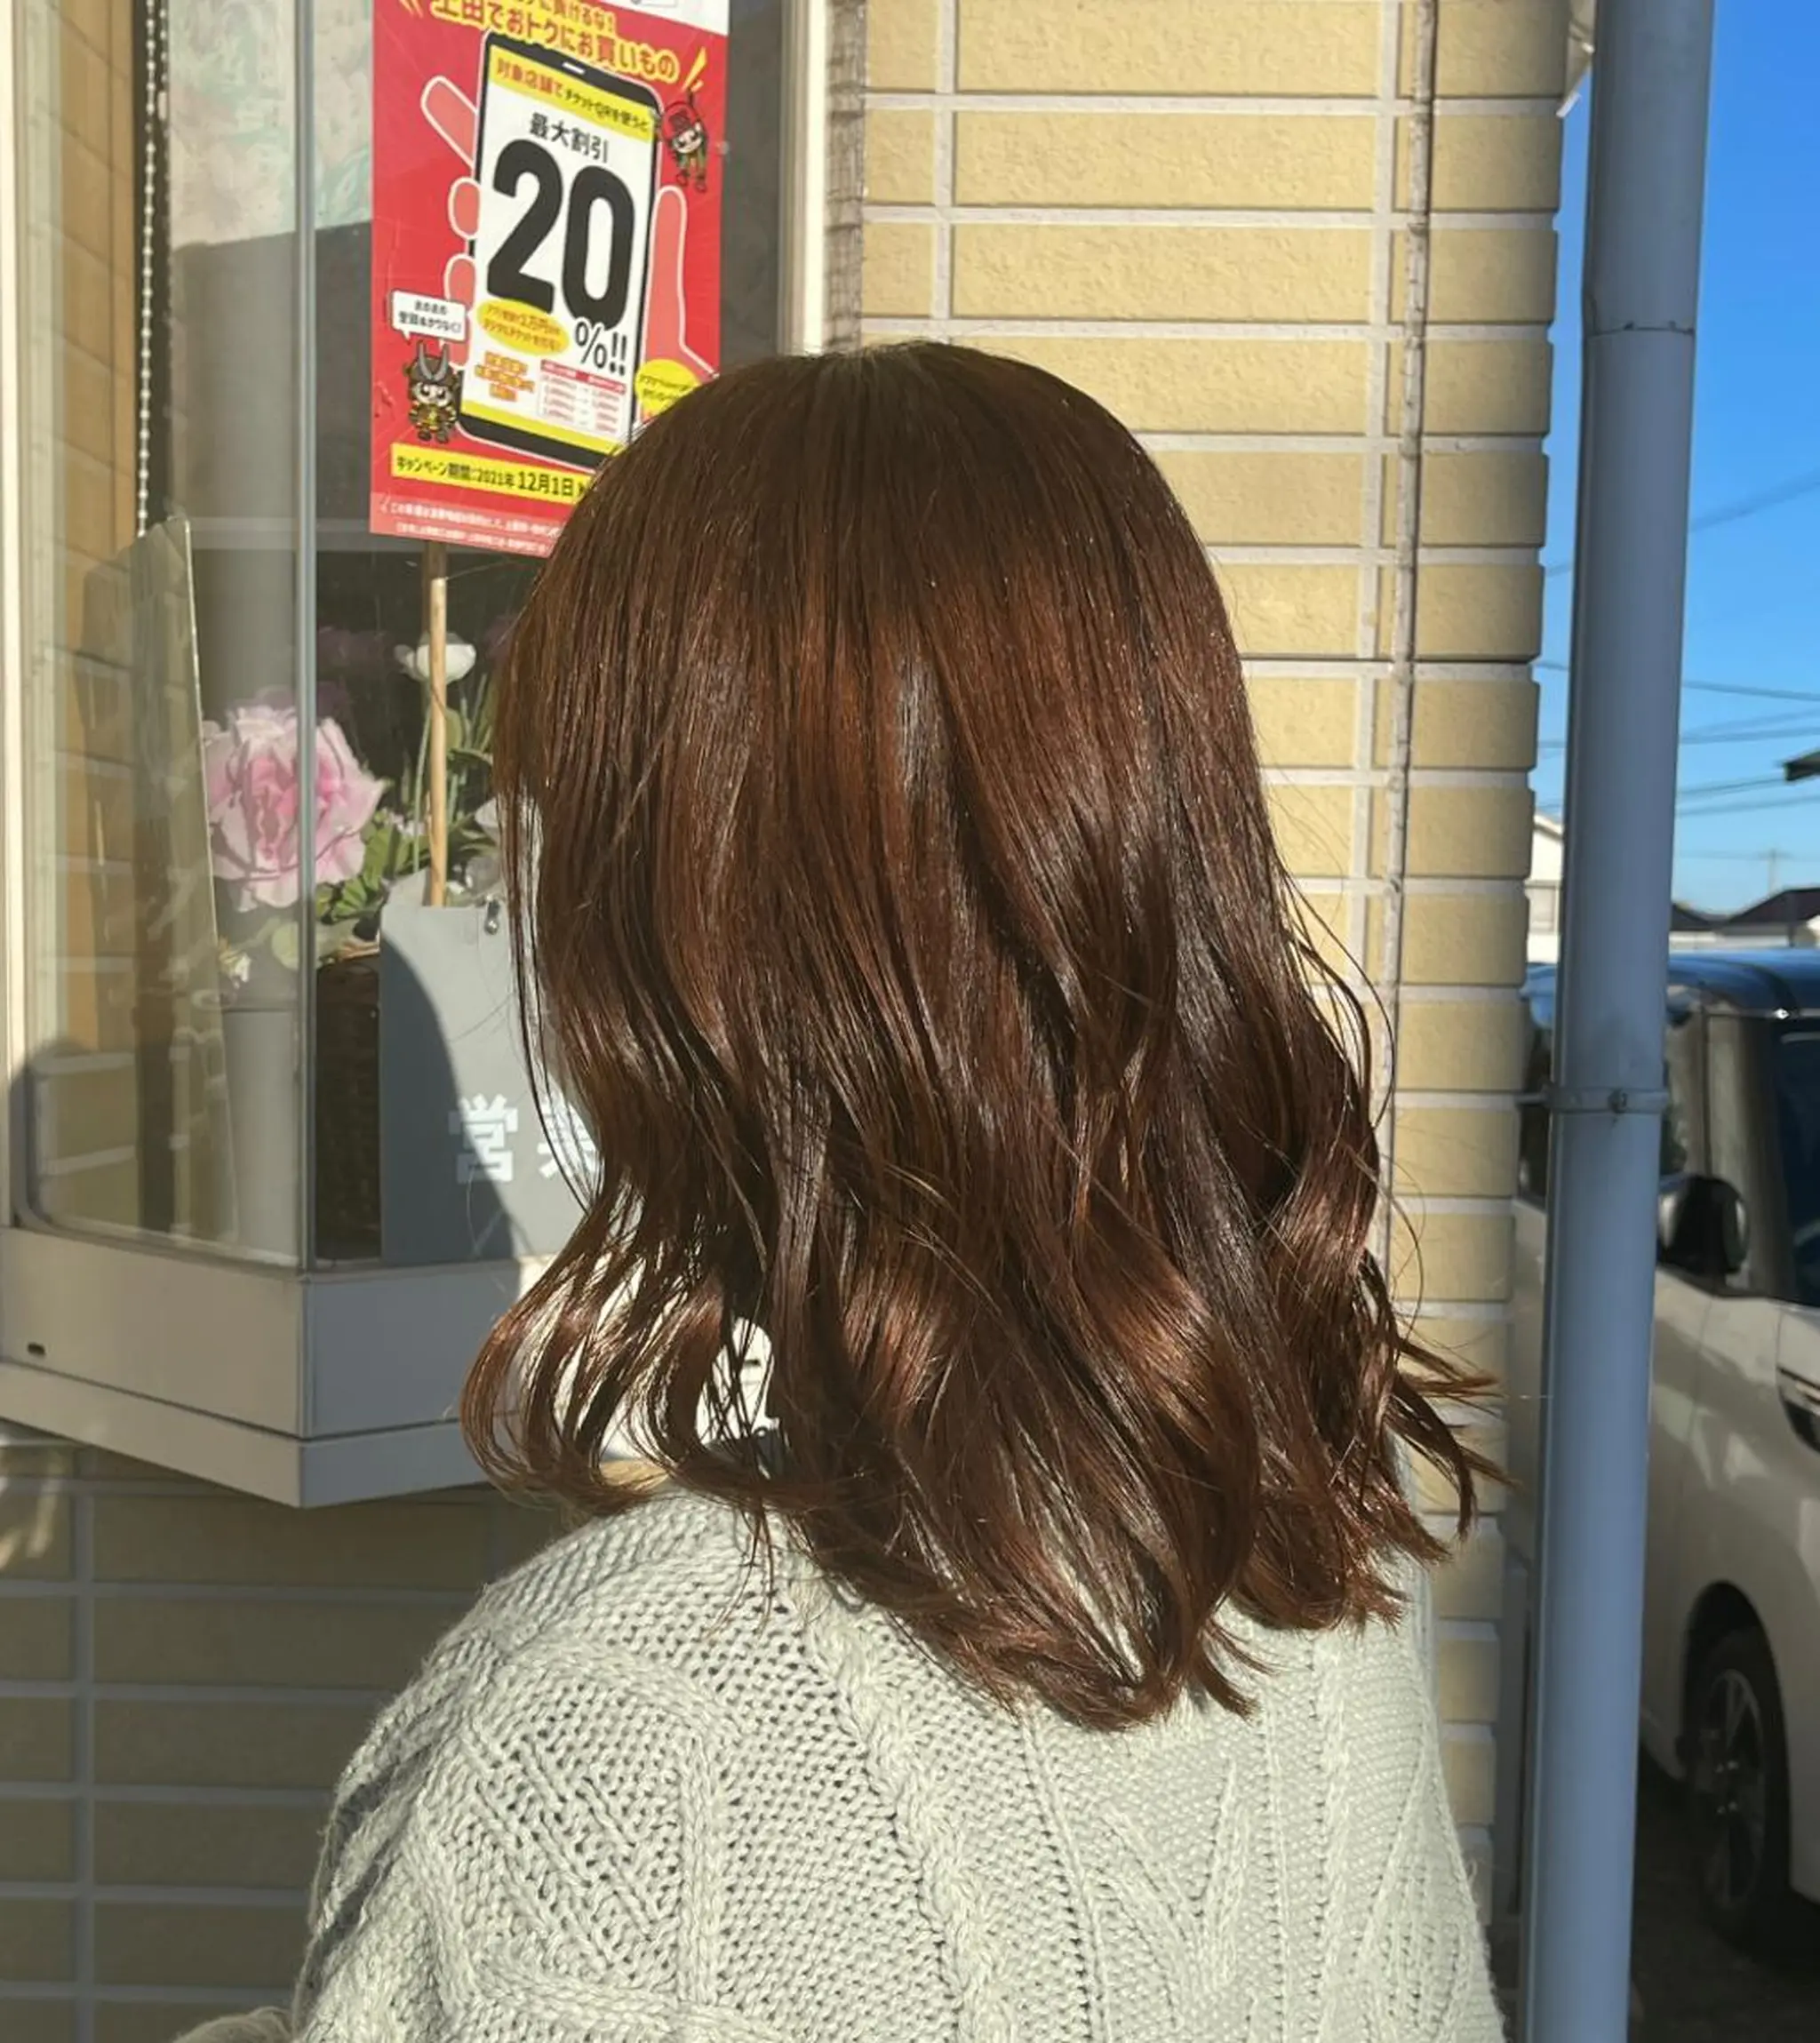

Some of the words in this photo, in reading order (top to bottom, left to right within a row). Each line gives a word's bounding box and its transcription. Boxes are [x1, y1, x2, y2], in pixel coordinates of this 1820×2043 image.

[529, 111, 610, 164] 最大割引
[486, 139, 636, 331] 20
